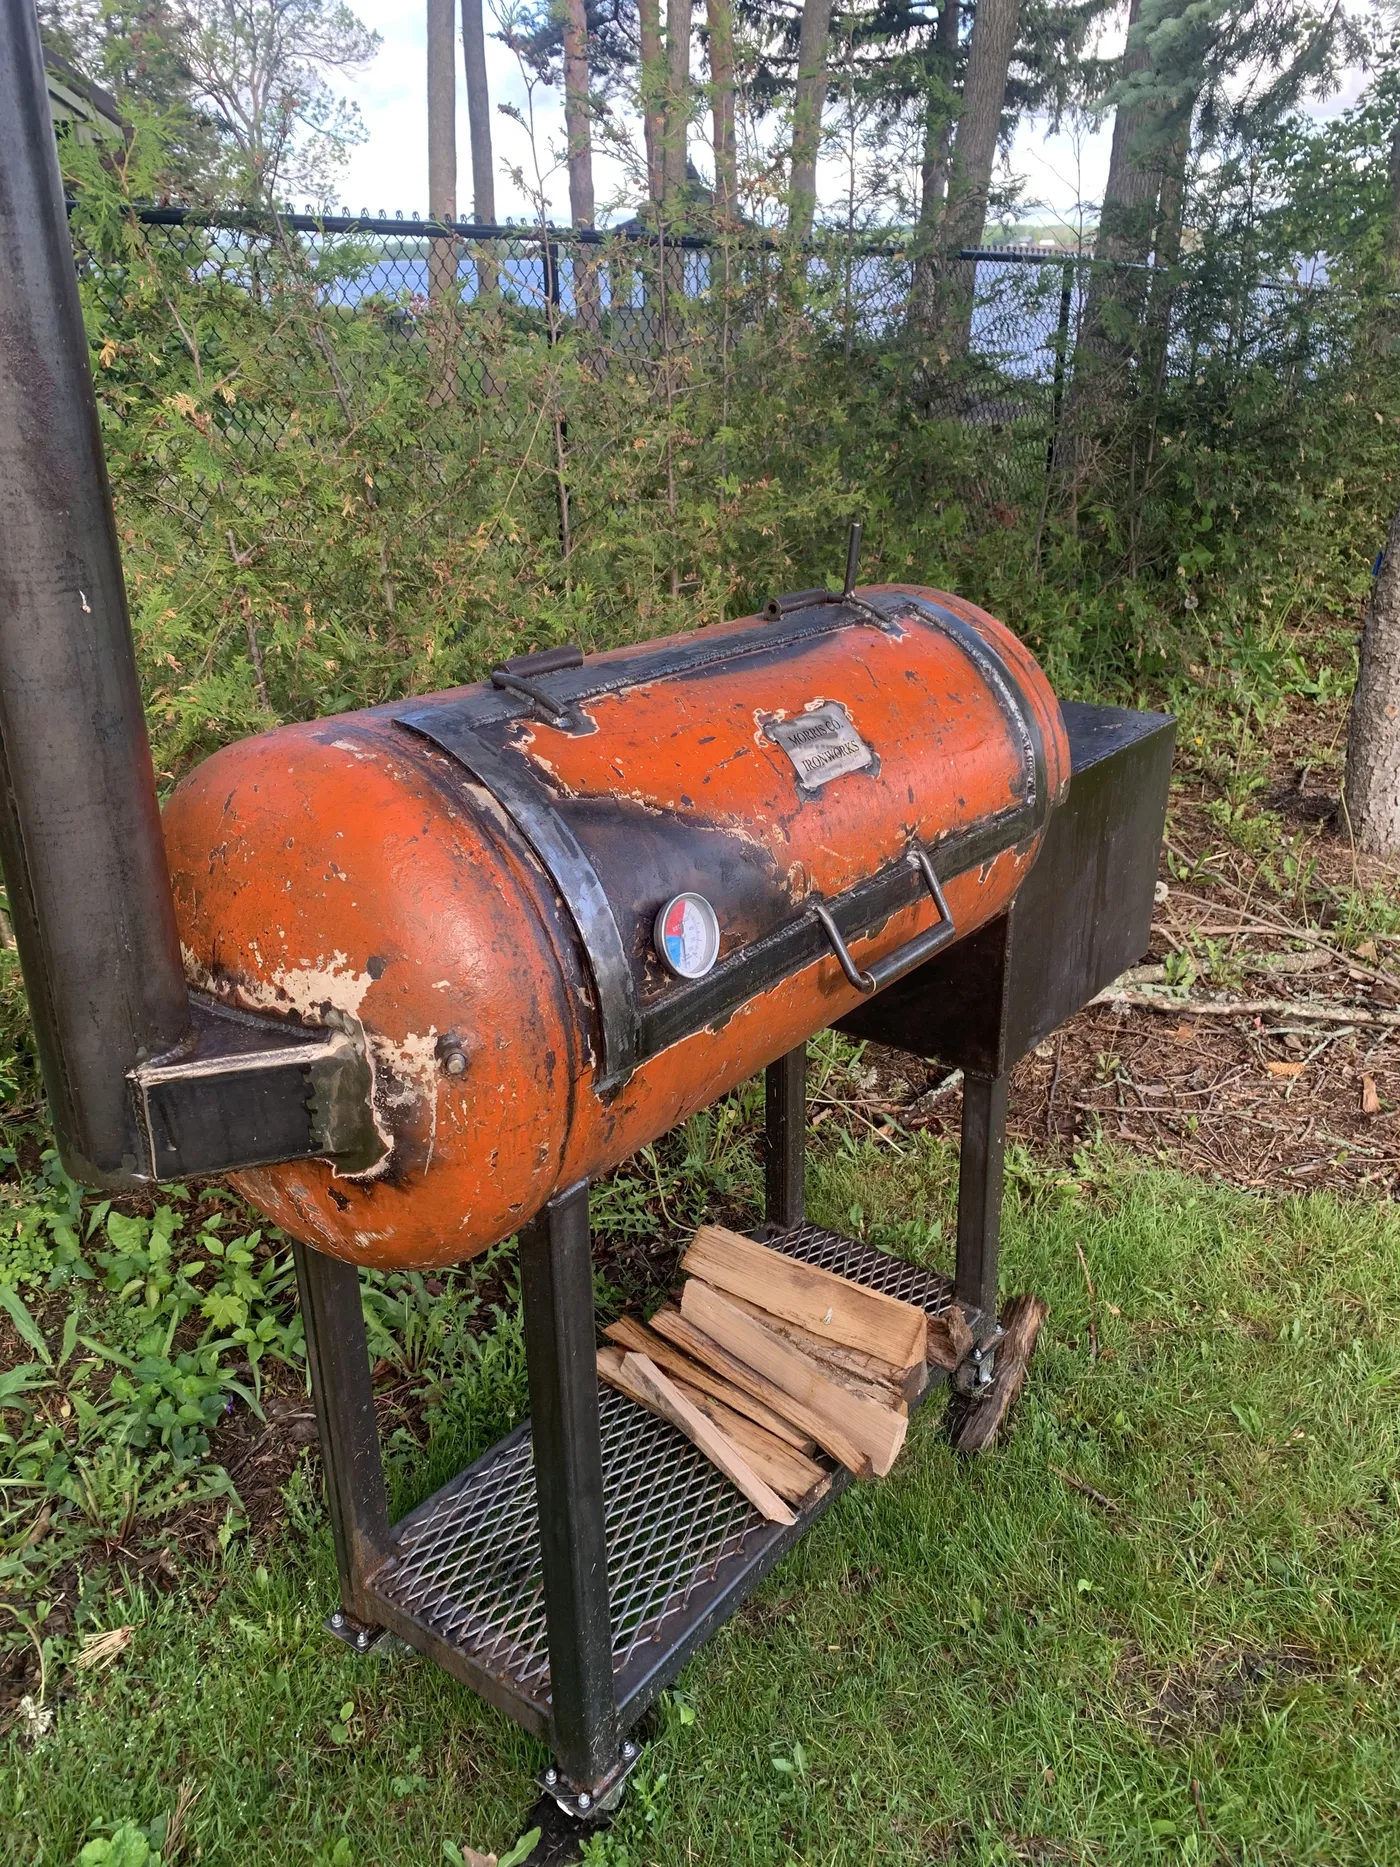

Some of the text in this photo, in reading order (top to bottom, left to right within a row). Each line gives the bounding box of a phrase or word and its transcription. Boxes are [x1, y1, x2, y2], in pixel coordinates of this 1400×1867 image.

[787, 719, 844, 747] MORRIS CO.
[801, 740, 860, 772] IRONWORKS
